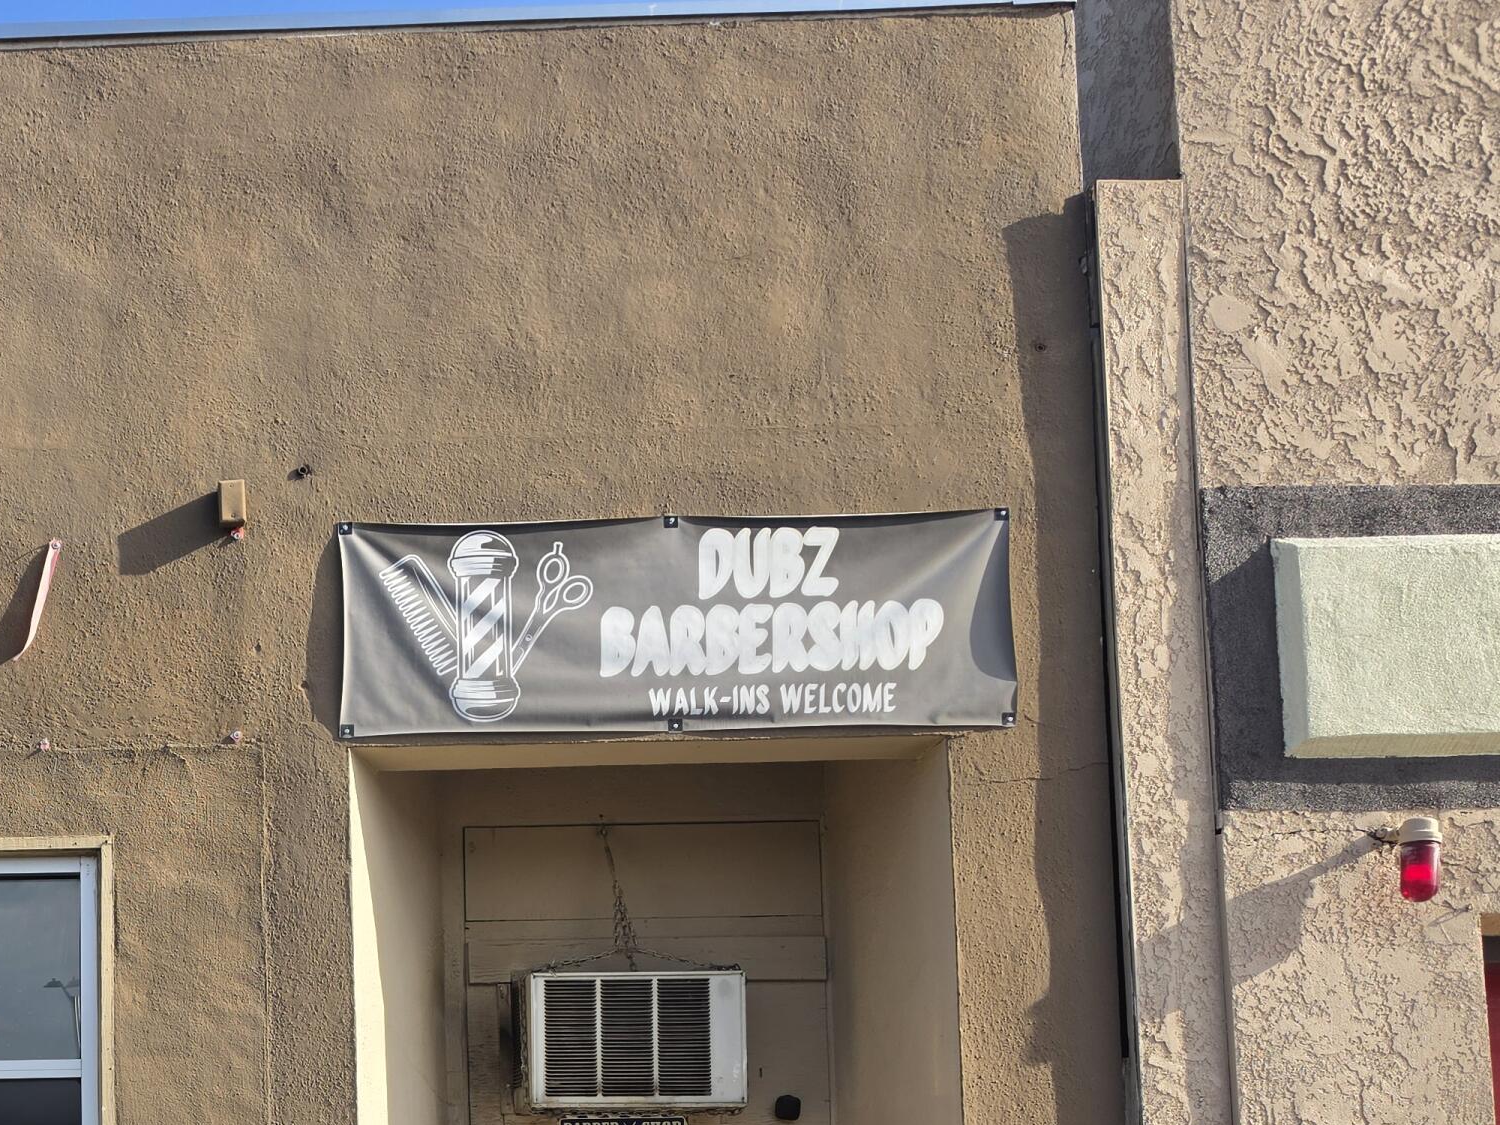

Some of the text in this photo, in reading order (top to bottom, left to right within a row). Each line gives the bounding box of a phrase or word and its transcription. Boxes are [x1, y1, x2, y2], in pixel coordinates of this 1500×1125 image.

[698, 526, 839, 600] DUBZ
[600, 598, 944, 678] BARBERSHOP
[649, 682, 897, 717] WALK-INS WELCOME
